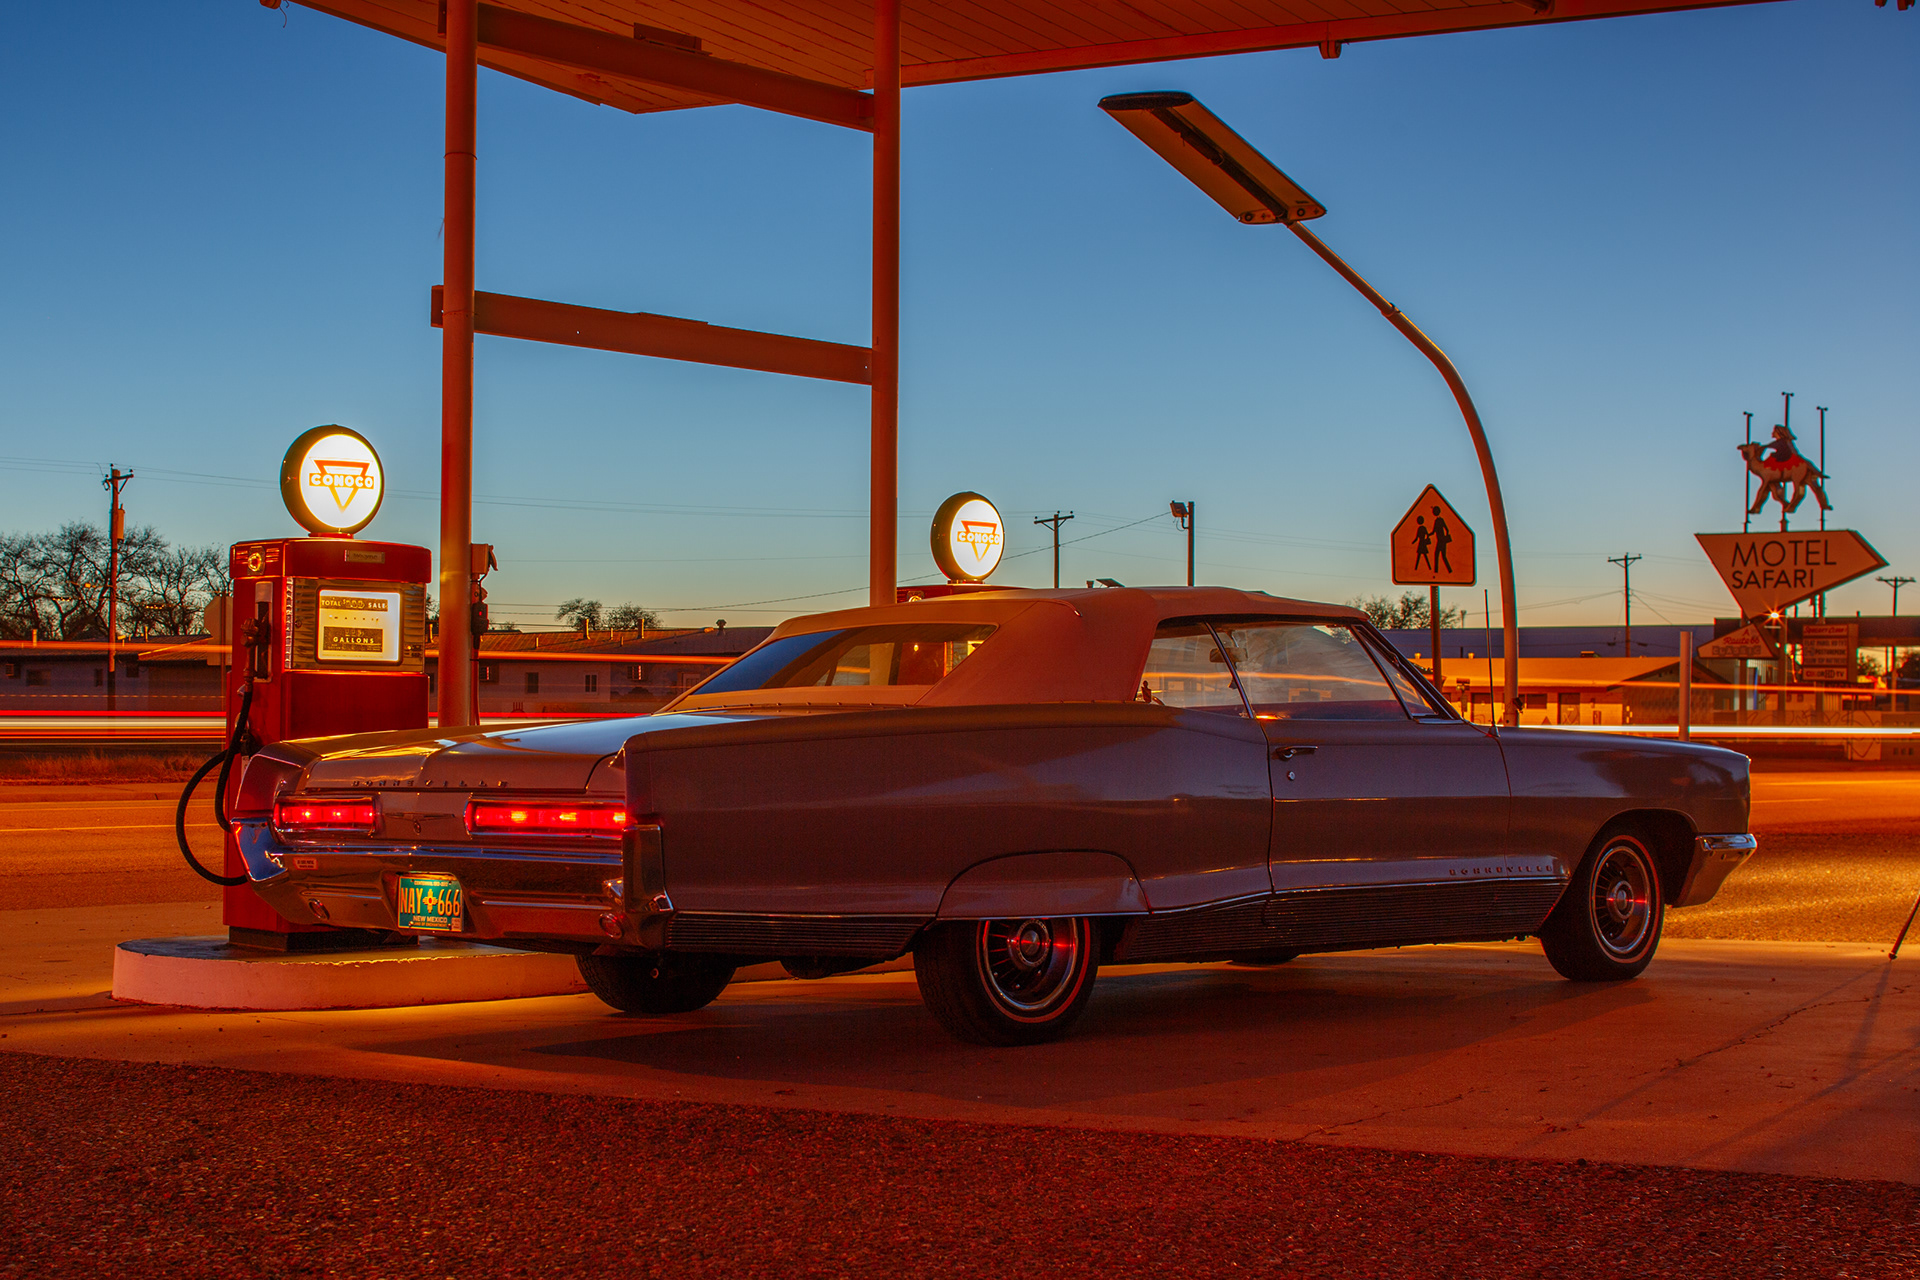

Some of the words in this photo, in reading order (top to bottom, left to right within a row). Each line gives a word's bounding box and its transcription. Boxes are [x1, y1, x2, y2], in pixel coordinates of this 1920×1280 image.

[311, 473, 374, 488] CONOCO
[958, 532, 1000, 544] CONOCO
[1731, 539, 1837, 568] MOTEL
[1731, 569, 1815, 590] SAFARI
[321, 599, 342, 607] TOTAL
[1742, 628, 1750, 637] A
[333, 636, 375, 645] GALLONS
[1723, 636, 1750, 645] Route
[1750, 635, 1760, 645] 66
[1712, 646, 1761, 656] CLASSIC
[400, 887, 424, 915] NAY
[437, 888, 461, 917] 666
[426, 916, 448, 924] MEXICO
